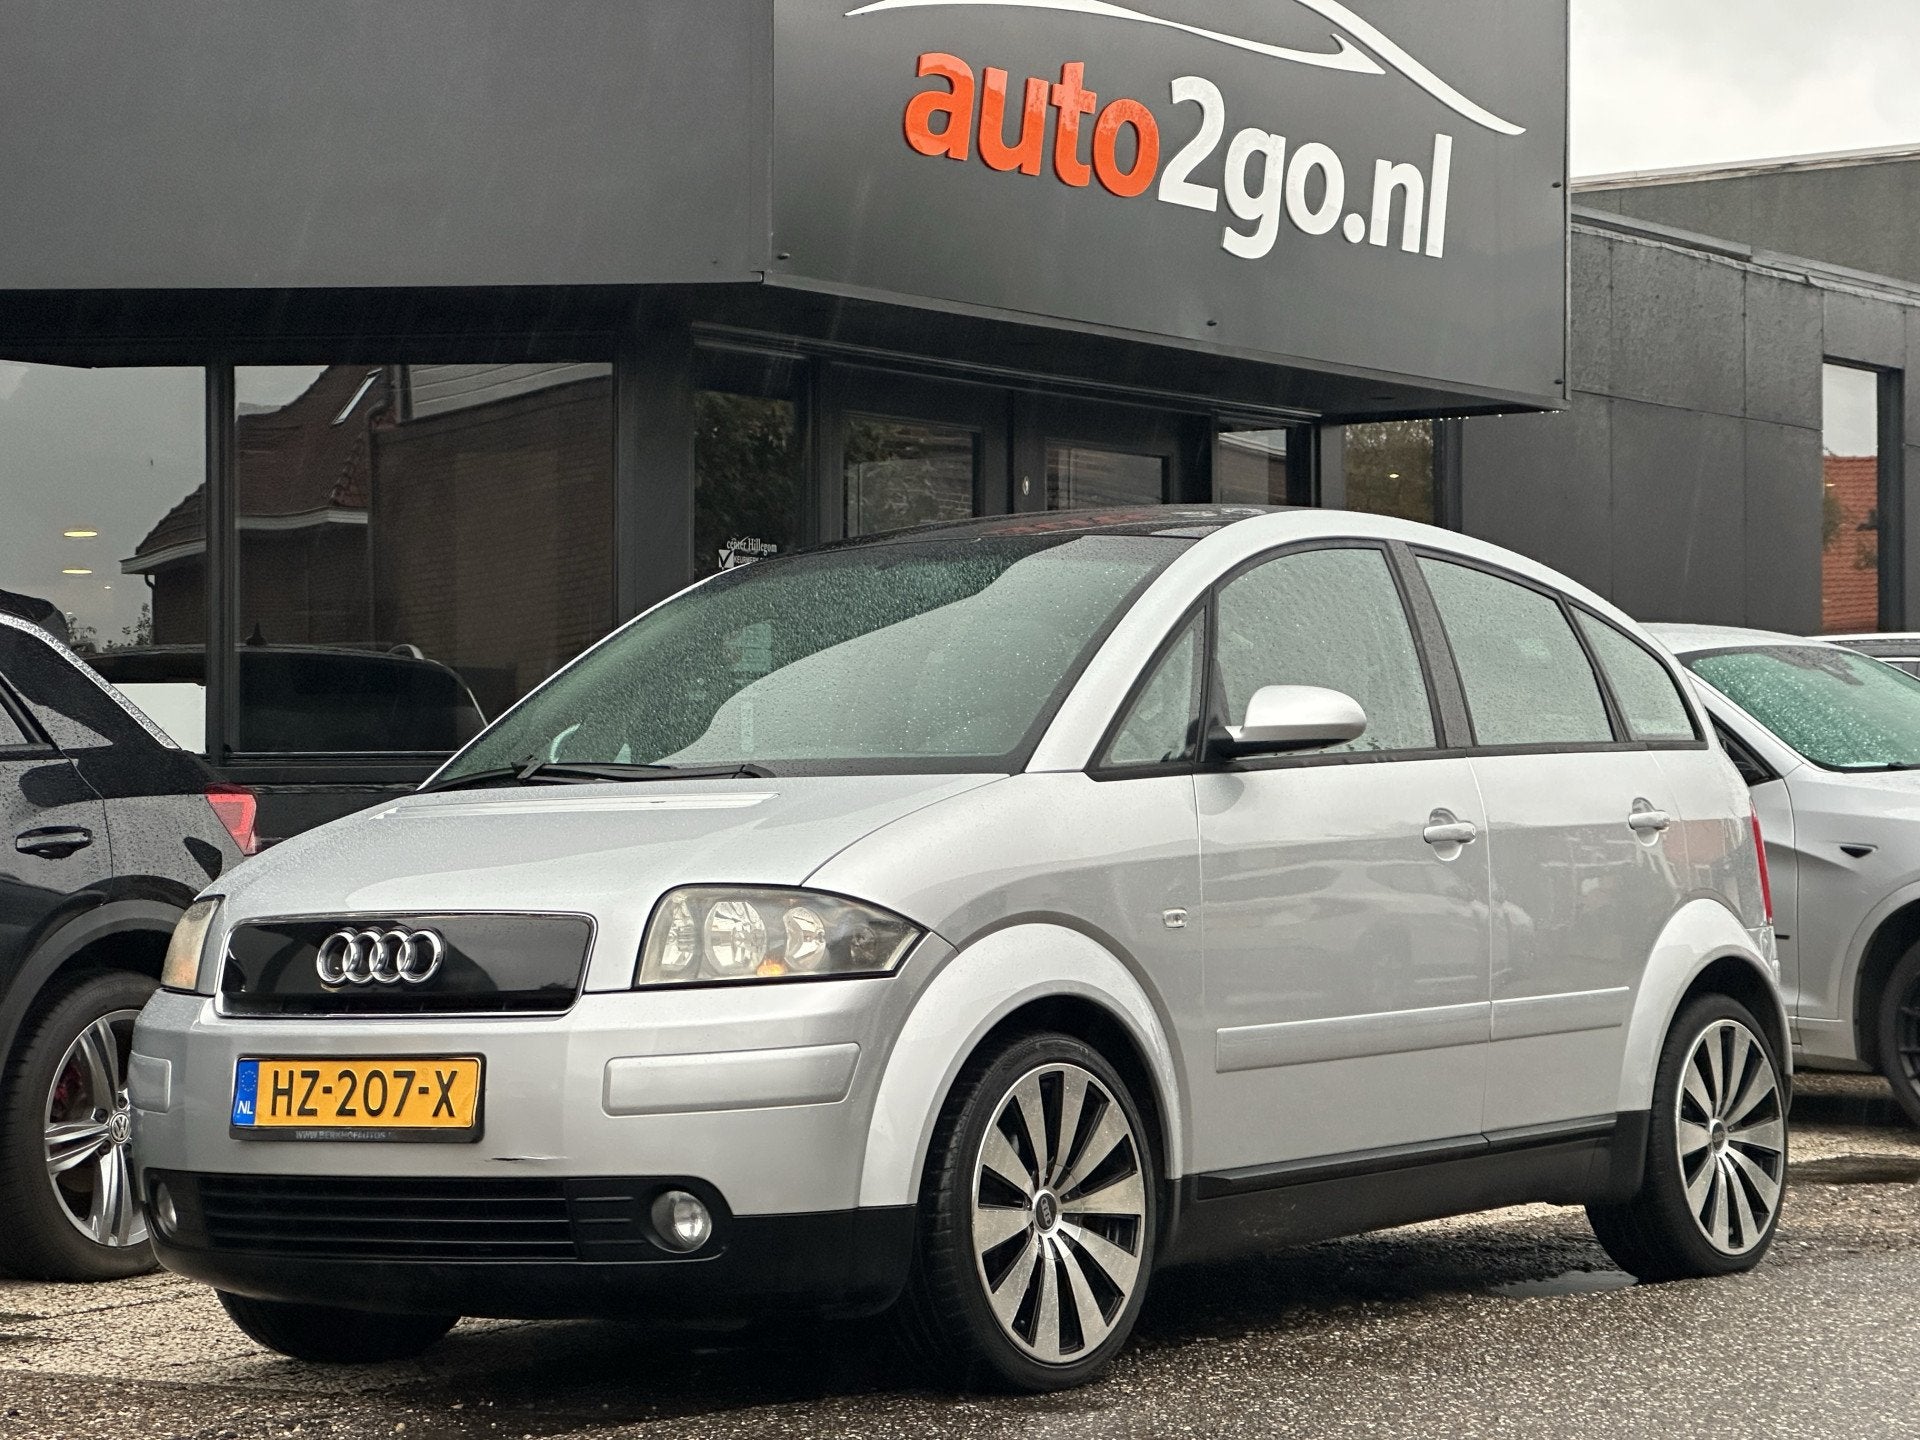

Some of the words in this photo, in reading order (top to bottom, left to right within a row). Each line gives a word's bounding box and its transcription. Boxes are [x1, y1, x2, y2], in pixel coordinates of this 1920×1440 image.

[905, 52, 1453, 259] auto2go.nl
[748, 537, 778, 556] Hillegom
[237, 1100, 253, 1114] NL
[271, 1069, 458, 1118] HZ-207-X
